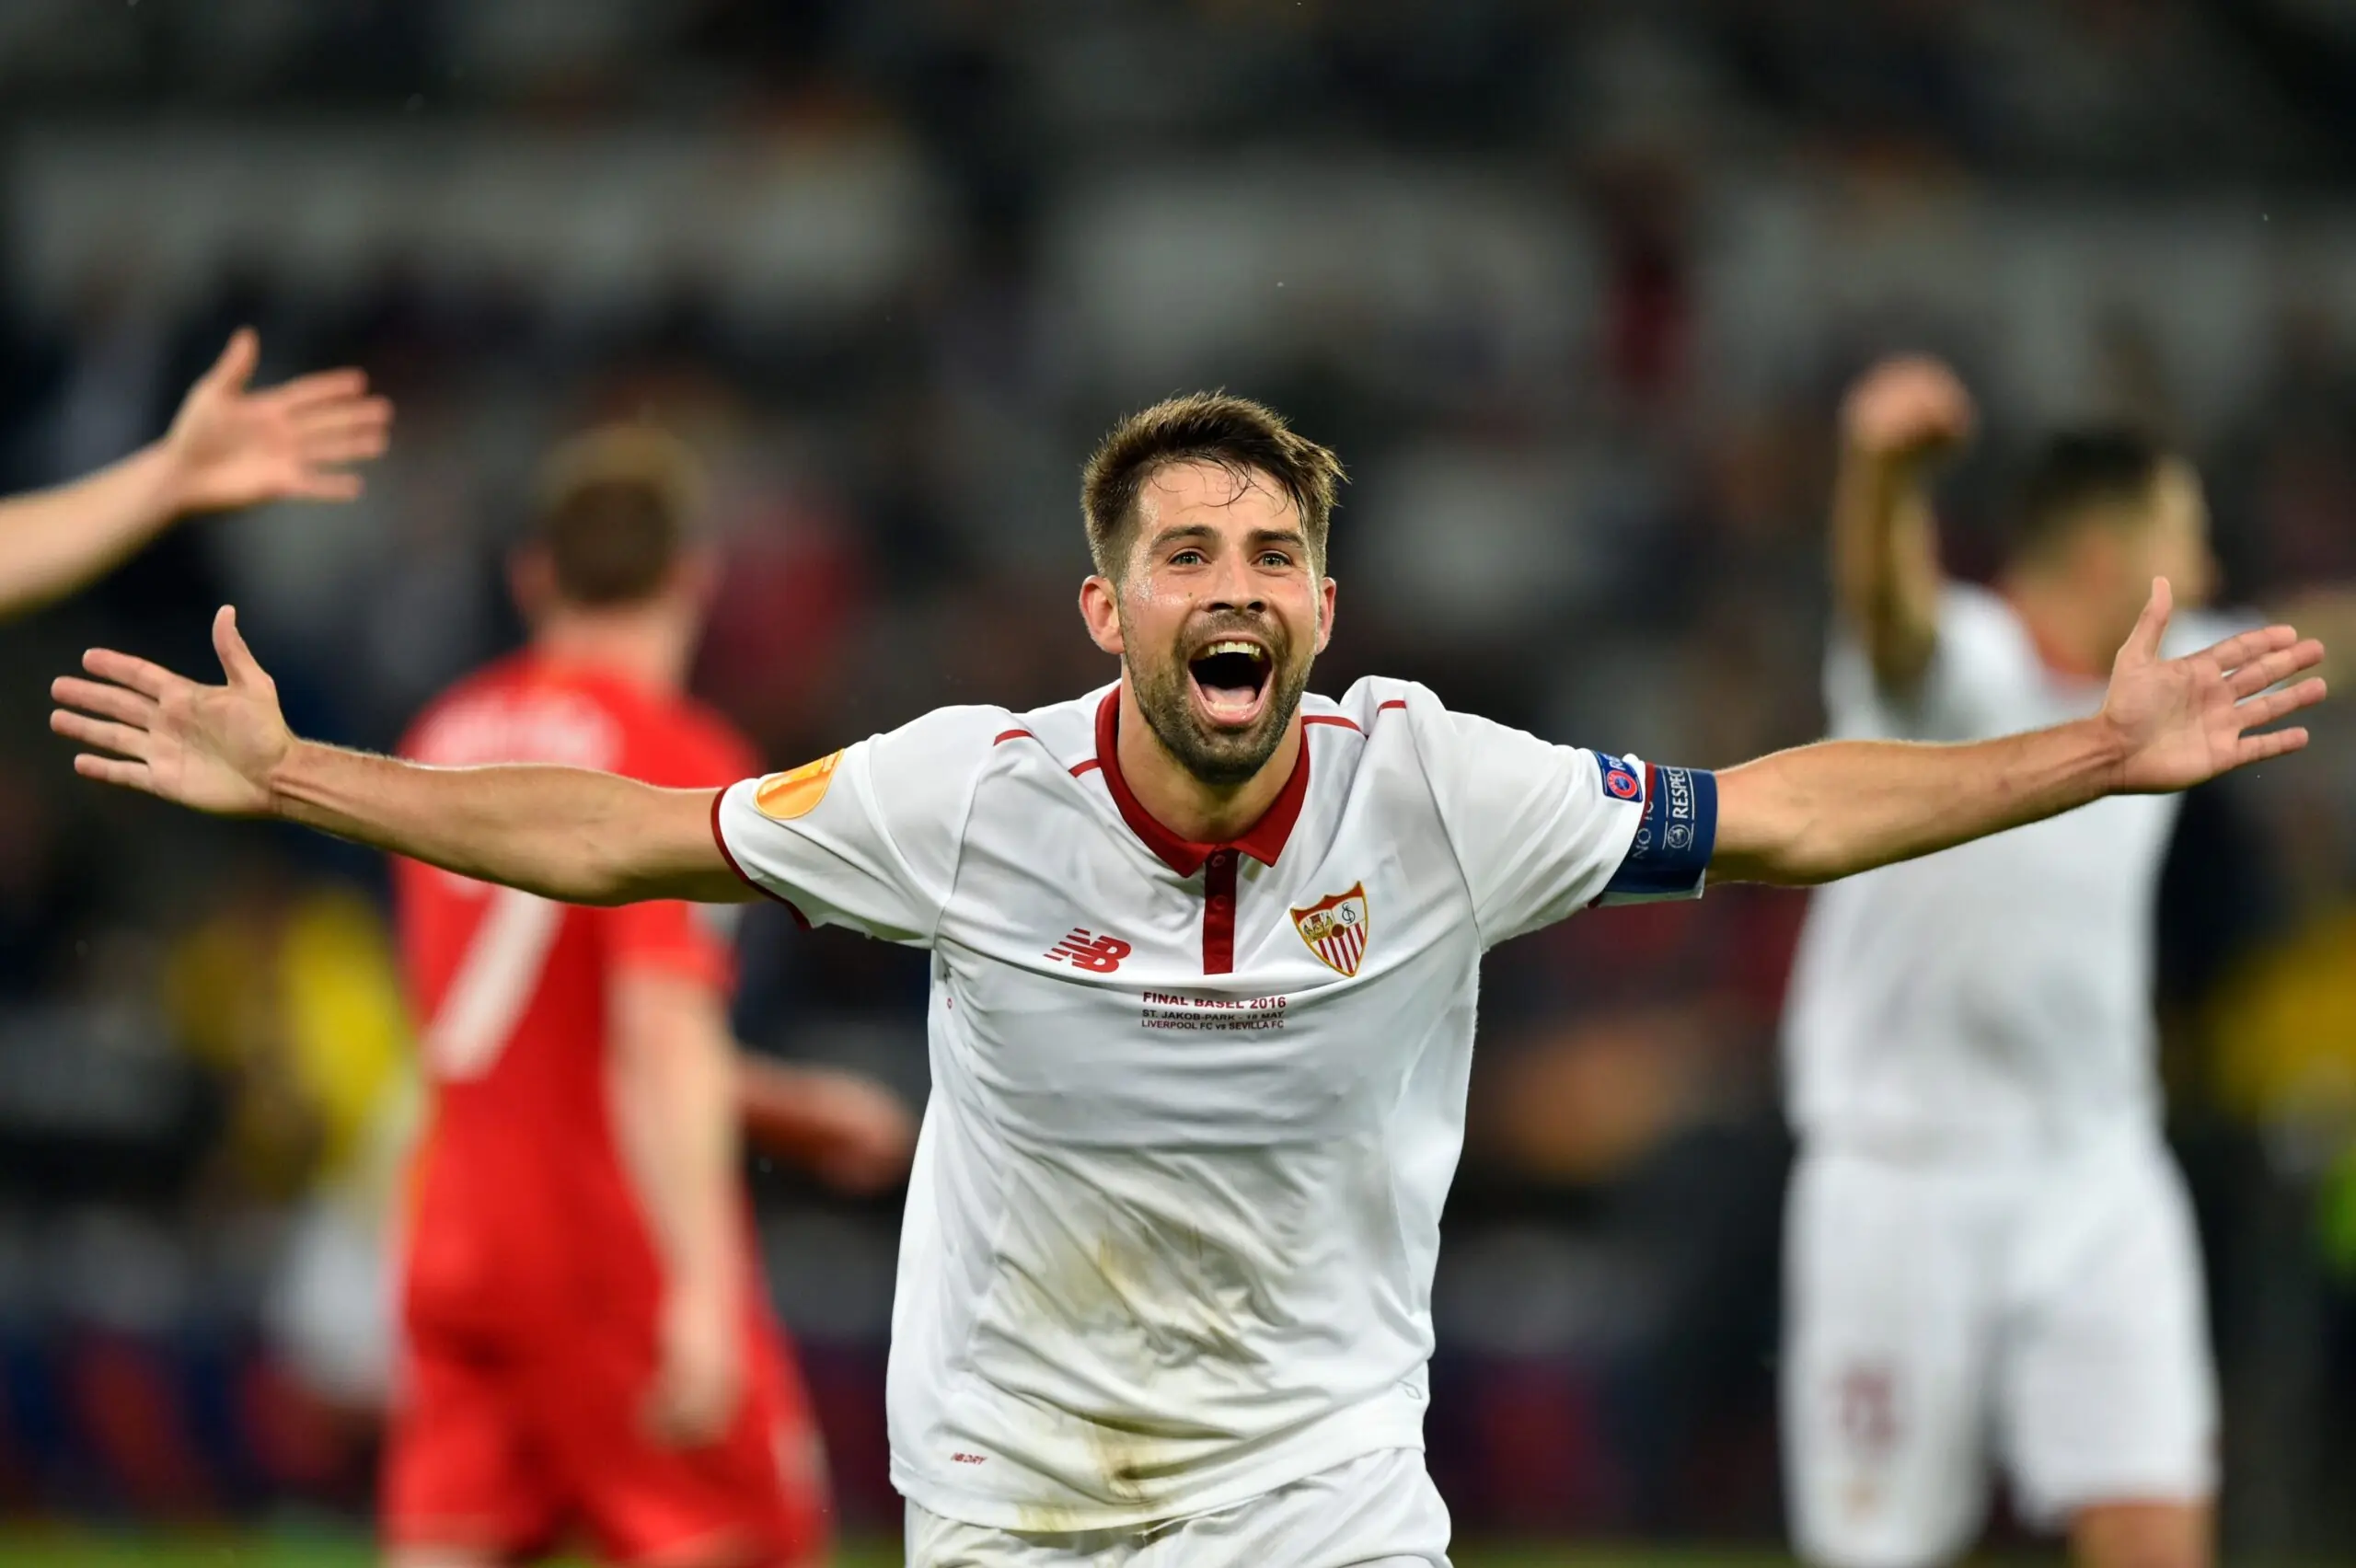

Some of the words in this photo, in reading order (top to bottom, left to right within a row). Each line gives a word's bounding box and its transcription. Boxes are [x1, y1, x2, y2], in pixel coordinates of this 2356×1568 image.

[1668, 767, 1689, 819] RESPEC
[1143, 991, 1189, 1007] FINAL
[1194, 997, 1245, 1009] BASEL
[1249, 996, 1287, 1009] 2016
[1141, 1009, 1159, 1019] ST.
[1161, 1011, 1235, 1021] JAKOB-PARK
[1261, 1010, 1285, 1020] MAY
[1141, 1020, 1198, 1030] LIVERPOOL
[1200, 1021, 1214, 1031] FC
[1229, 1020, 1270, 1031] SEVILLA
[1271, 1020, 1285, 1029] FC
